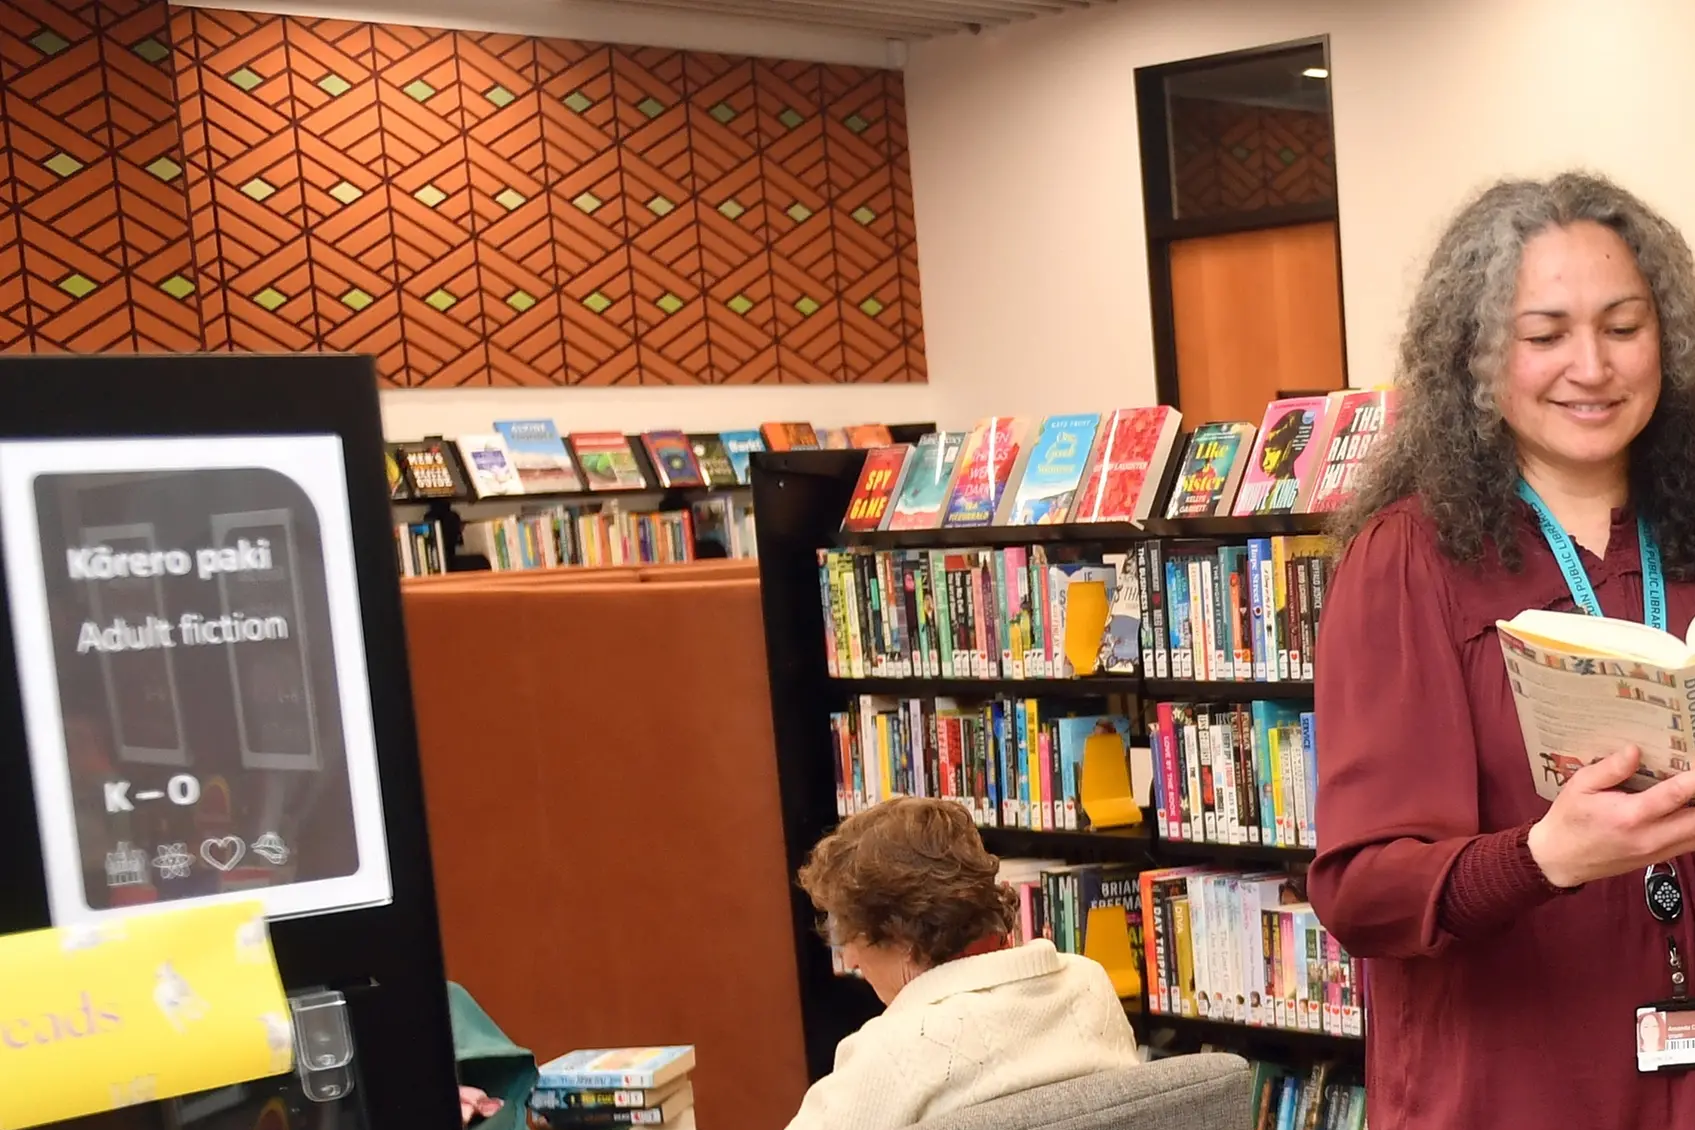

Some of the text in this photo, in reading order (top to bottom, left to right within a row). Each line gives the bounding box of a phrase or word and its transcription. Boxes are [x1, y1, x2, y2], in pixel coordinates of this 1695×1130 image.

[1351, 407, 1380, 432] THE
[1196, 442, 1229, 459] Like
[1327, 436, 1369, 461] RABB
[866, 470, 890, 491] SPY
[850, 497, 887, 520] GAME
[197, 539, 272, 580] paki
[1250, 544, 1260, 603] Hope Street
[1646, 549, 1660, 588] PUBLIC
[1137, 547, 1148, 611] THE BUSINESS
[1311, 559, 1322, 609] BUFFALO JUSTICE
[76, 611, 288, 653] Adult fiction
[1302, 718, 1311, 749] SERVICE
[1163, 736, 1176, 817] LOVE BOOK
[104, 774, 201, 811] K O
[1101, 880, 1141, 897] BRIAN
[1153, 907, 1163, 934] DAY
[1174, 906, 1184, 934] DIVA
